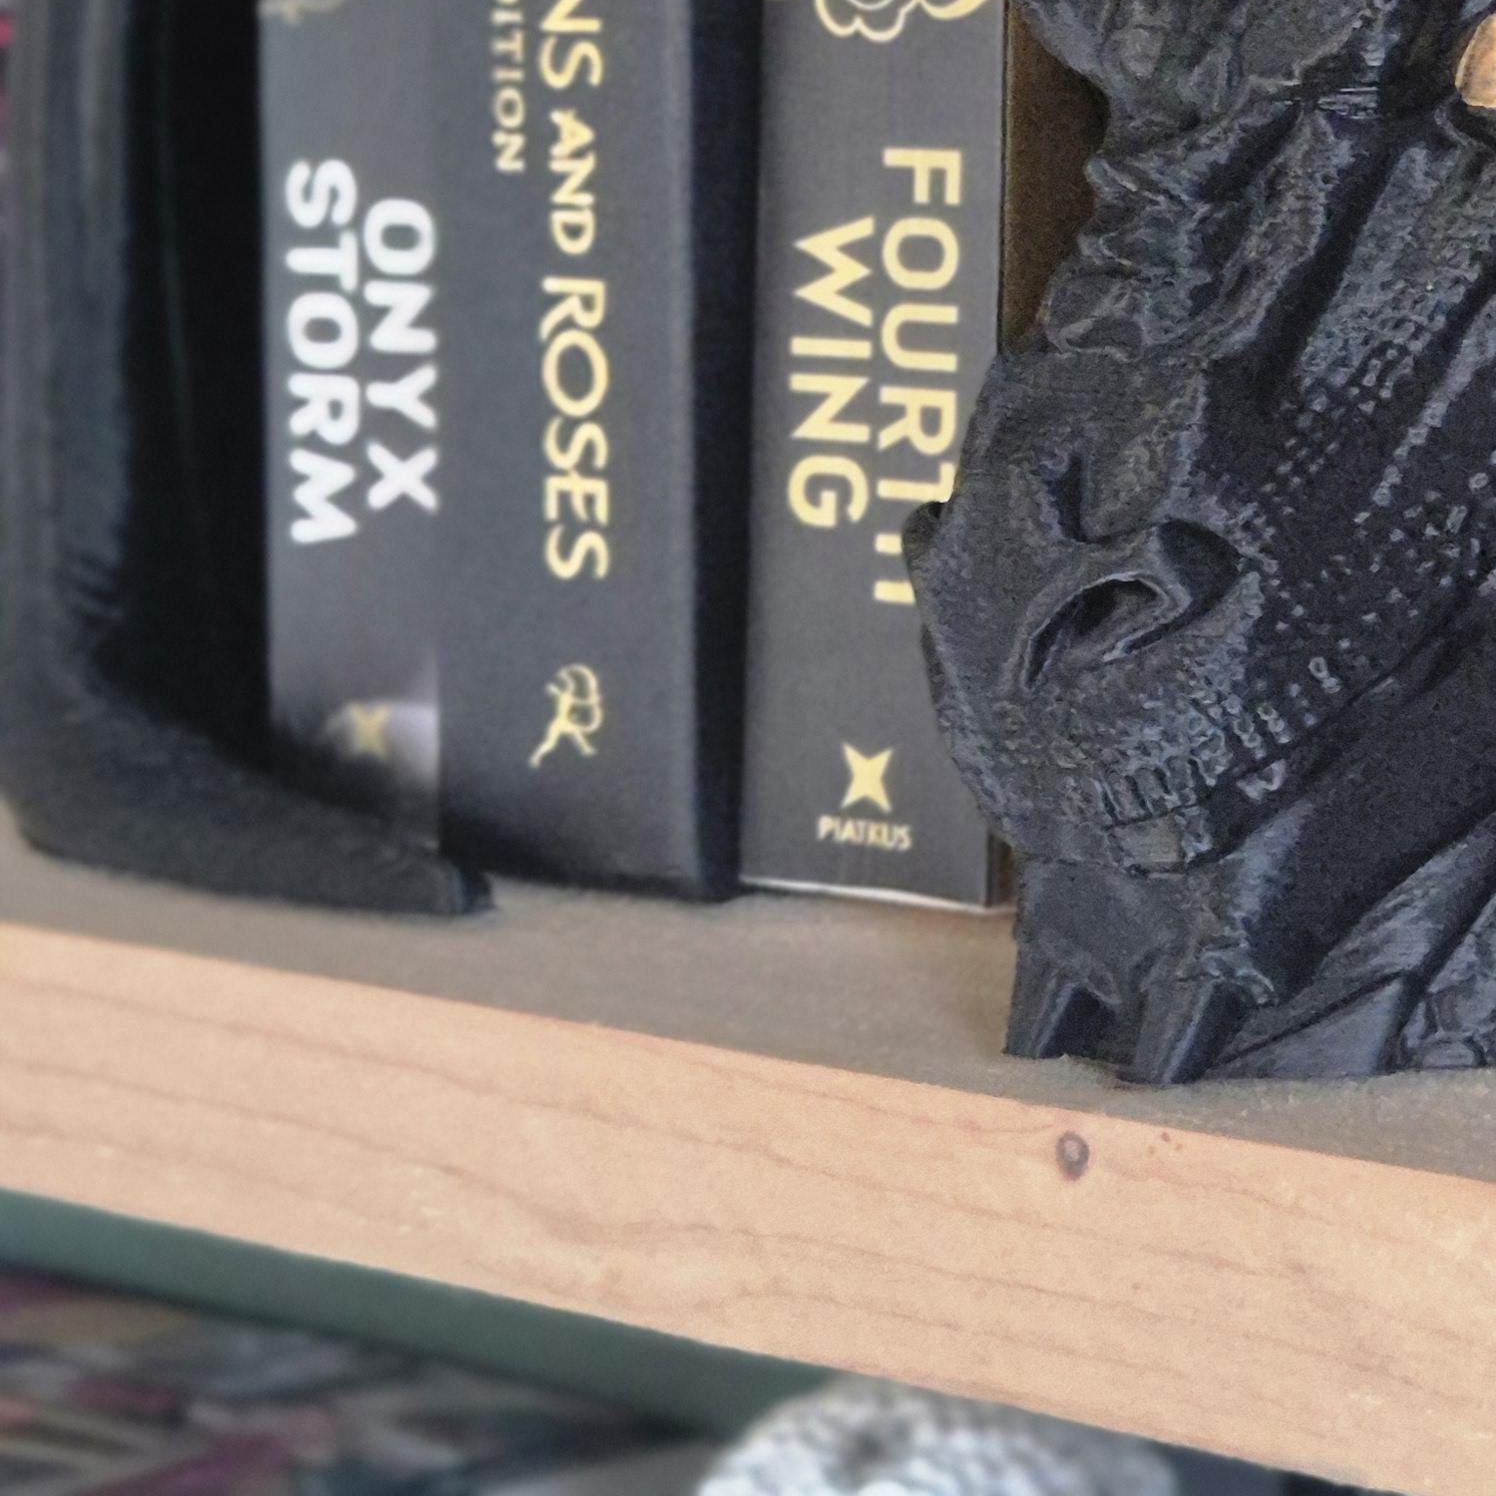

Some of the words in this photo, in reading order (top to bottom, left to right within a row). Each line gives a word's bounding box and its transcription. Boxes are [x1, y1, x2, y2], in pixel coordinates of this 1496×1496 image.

[548, 107, 598, 255] AND
[285, 157, 361, 546] STORM
[363, 197, 439, 514] ONYX
[539, 275, 611, 580] ROSES
[788, 214, 876, 530] WING
[873, 147, 962, 606] FOURT
[817, 814, 912, 851] PIATKUS
